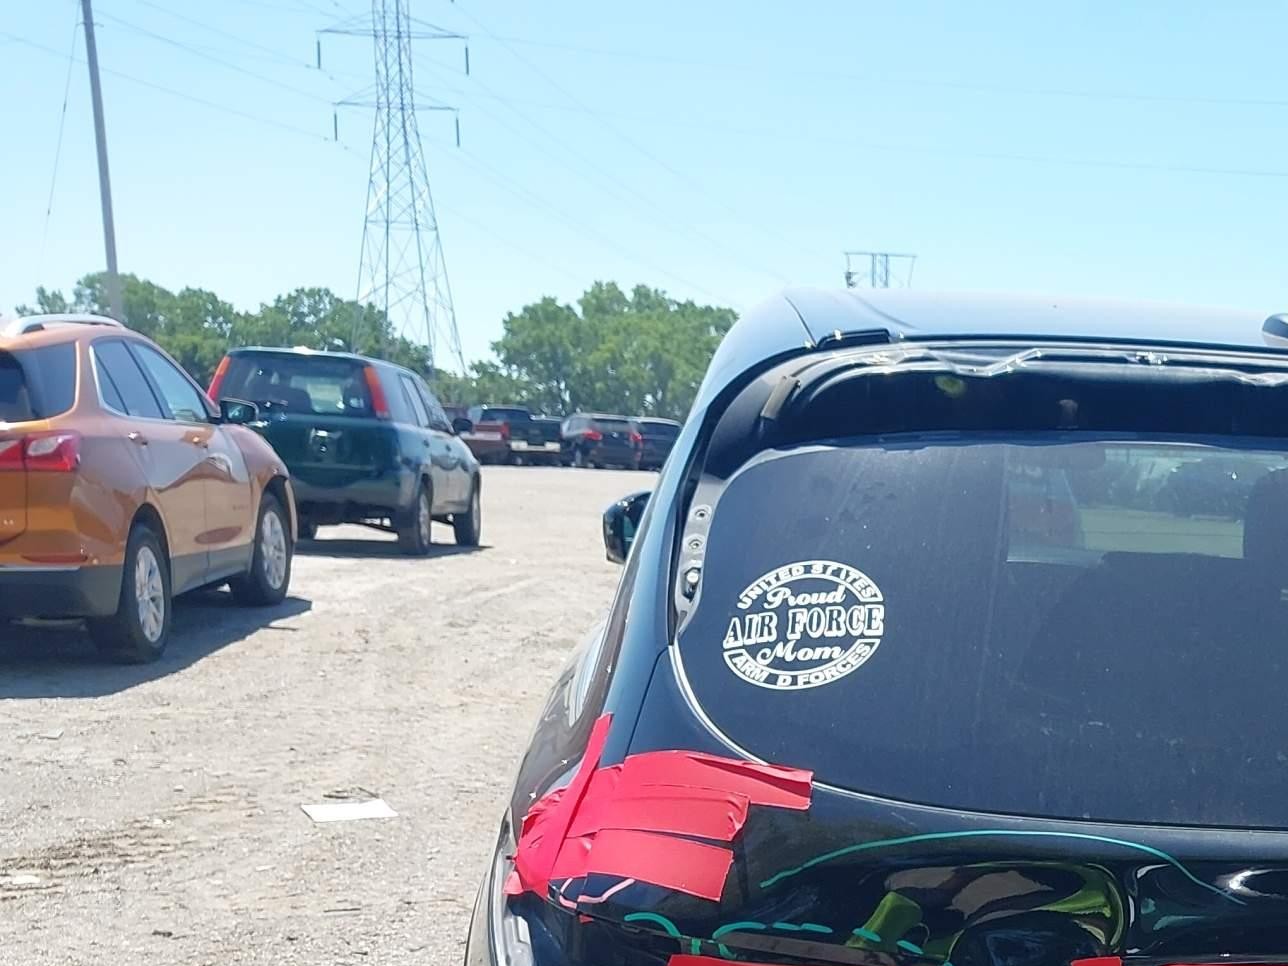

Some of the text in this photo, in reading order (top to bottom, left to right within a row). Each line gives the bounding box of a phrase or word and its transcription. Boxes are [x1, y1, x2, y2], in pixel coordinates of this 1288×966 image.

[763, 583, 846, 609] Proud
[723, 604, 884, 649] AIR FORCE
[756, 640, 846, 665] Mom
[797, 643, 873, 687] FORCES
